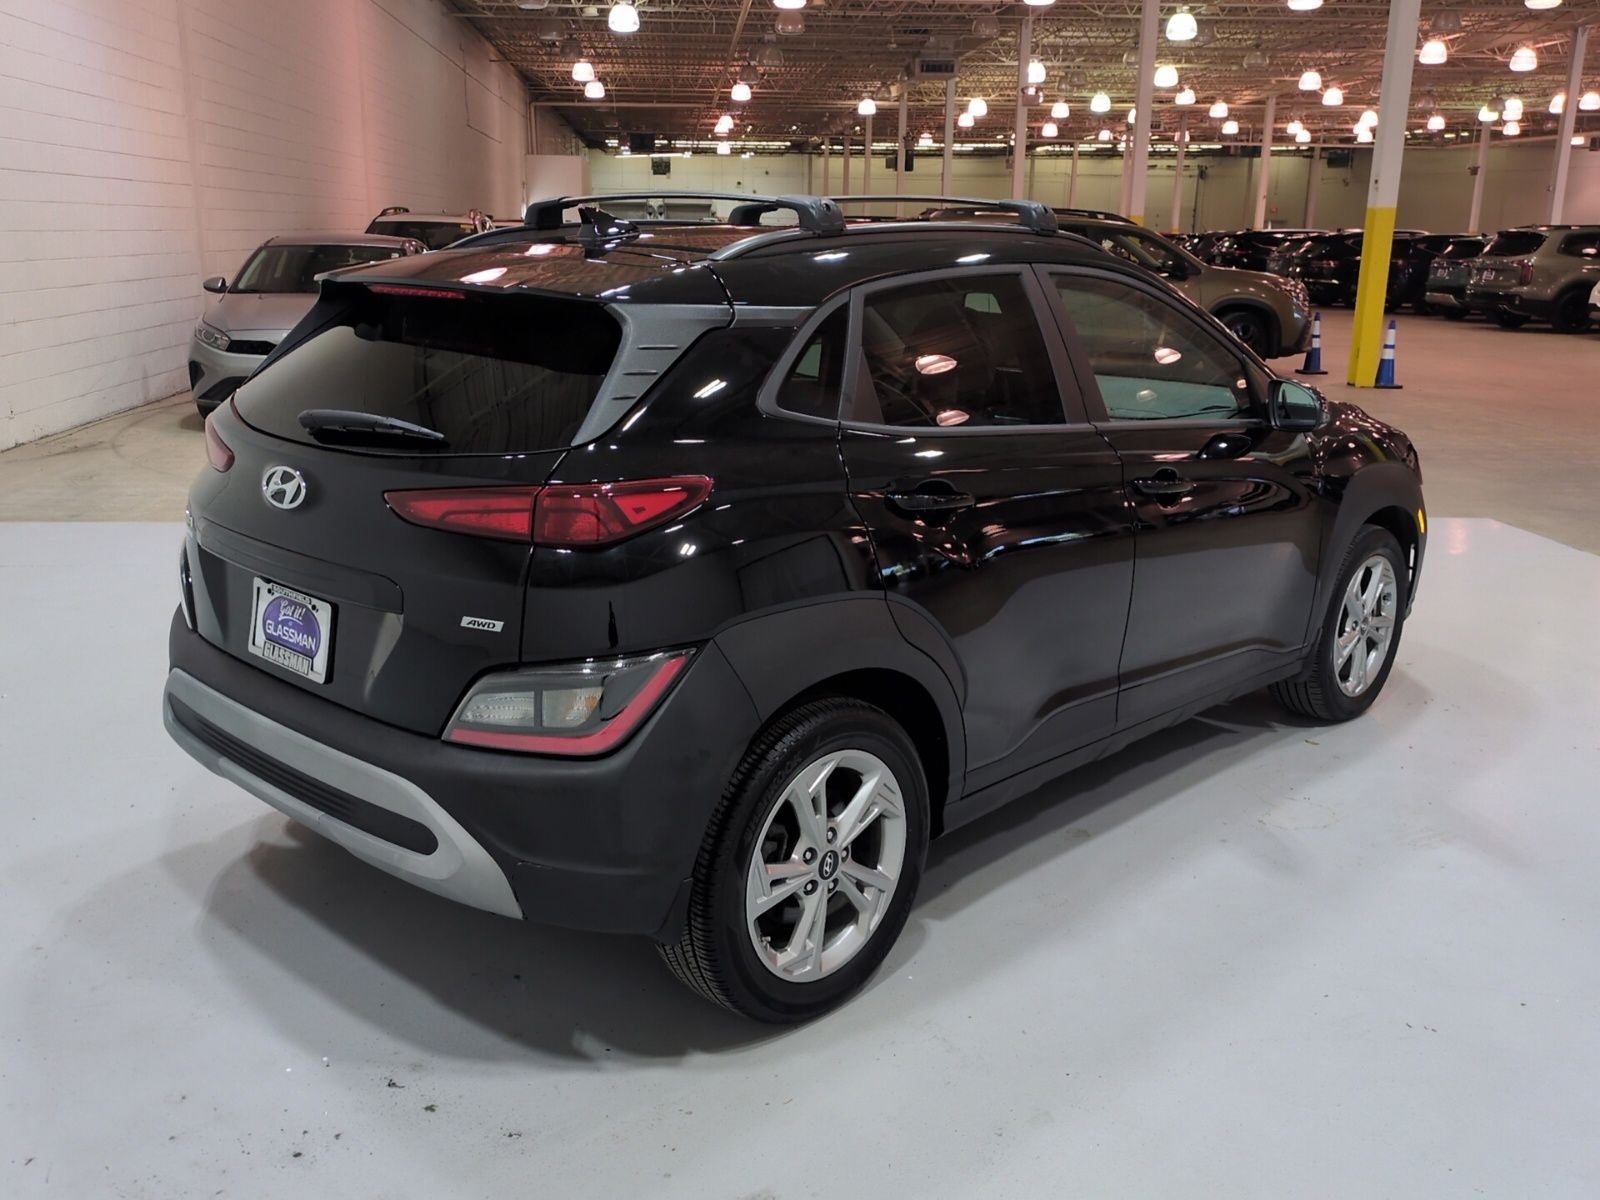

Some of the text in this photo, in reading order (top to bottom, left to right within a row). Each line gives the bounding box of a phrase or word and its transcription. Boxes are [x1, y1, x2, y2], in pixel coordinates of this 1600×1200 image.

[279, 599, 306, 620] Got it!
[265, 620, 316, 650] GLASSMAN
[467, 619, 496, 629] AWD
[264, 644, 309, 675] GLASSMAN
